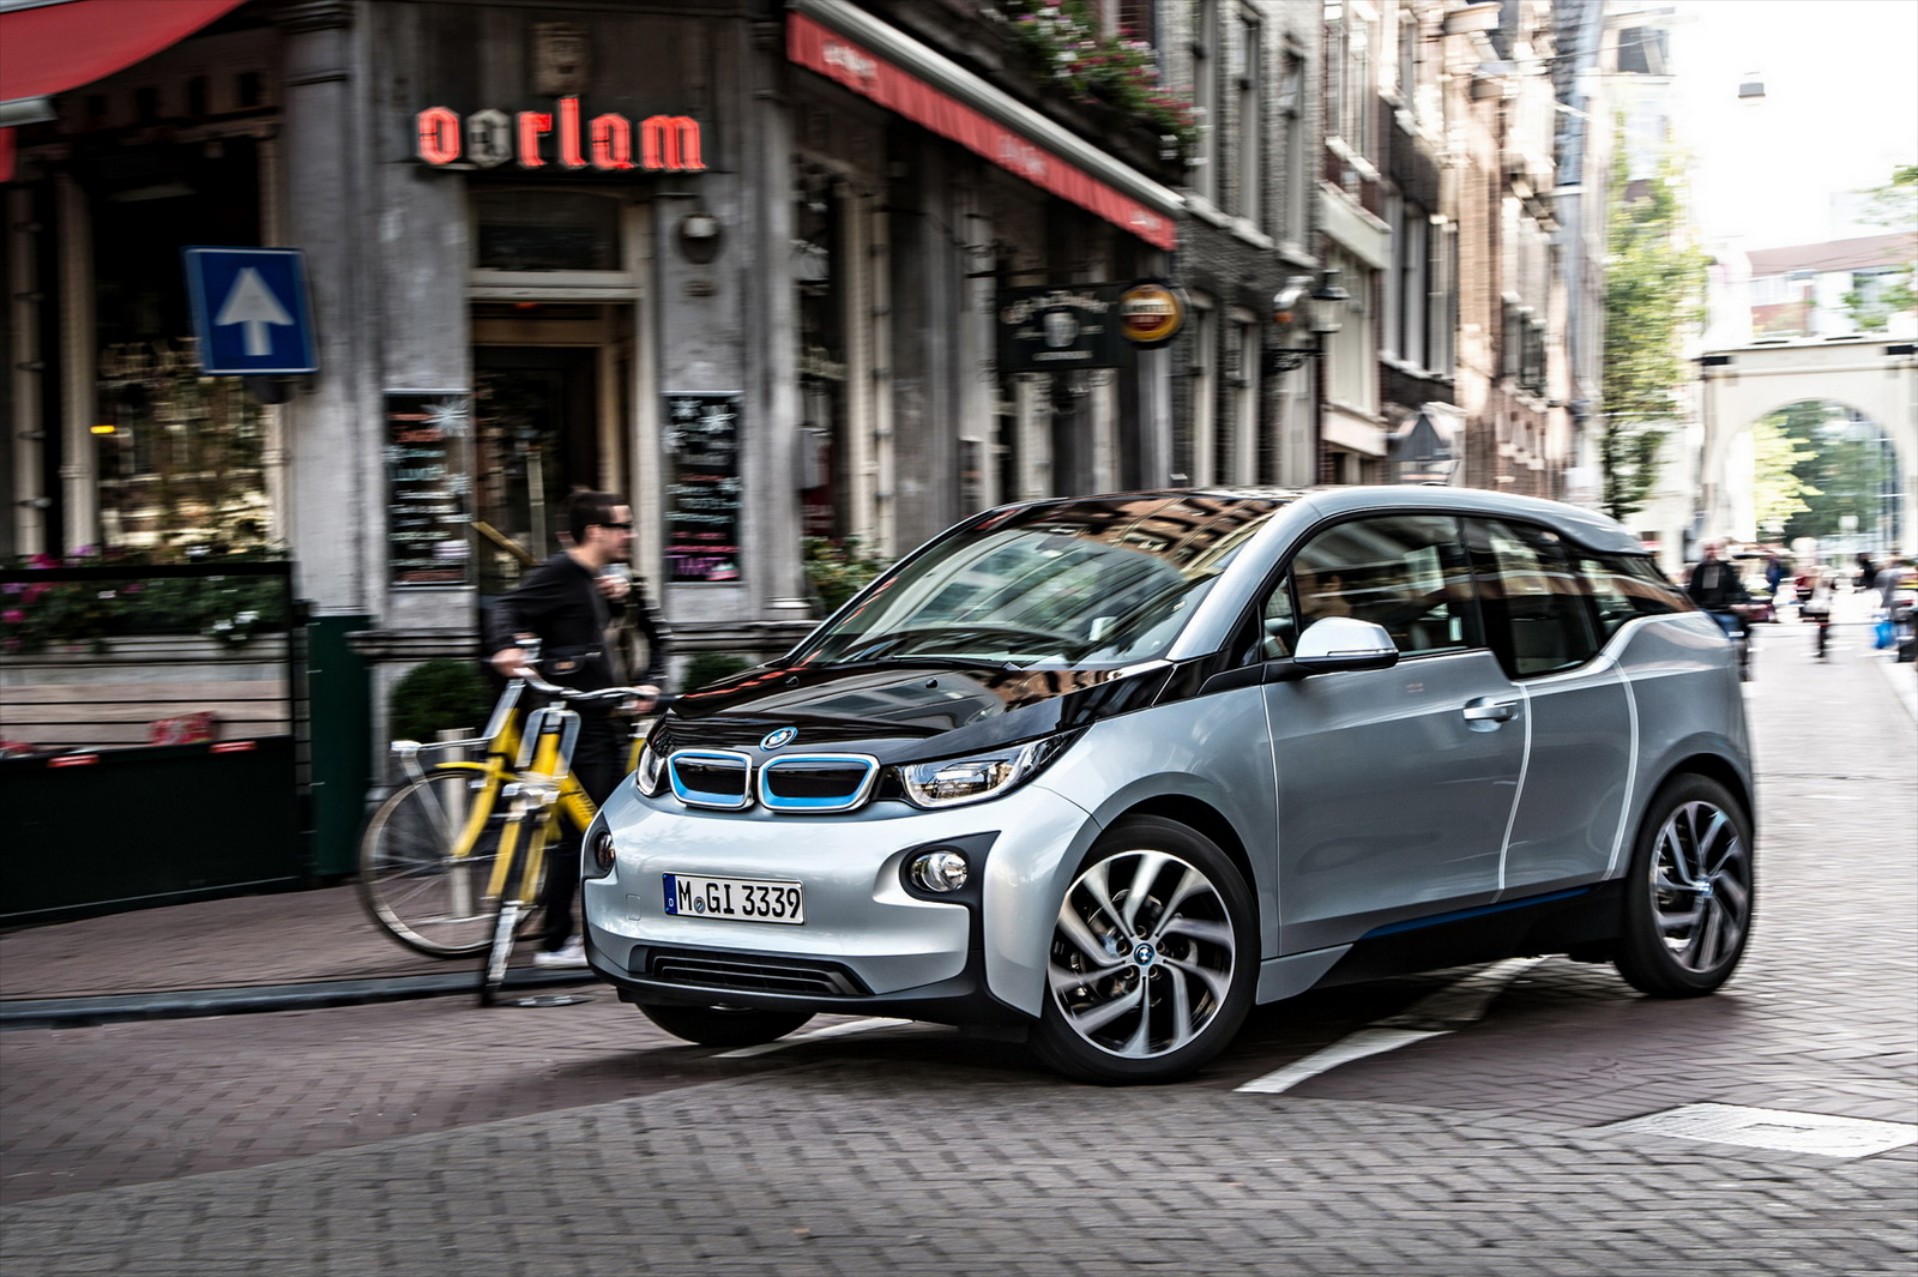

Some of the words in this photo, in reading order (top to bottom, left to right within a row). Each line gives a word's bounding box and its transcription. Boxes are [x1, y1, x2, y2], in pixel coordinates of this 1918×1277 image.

[416, 96, 707, 170] oorlam
[678, 880, 692, 911] M
[706, 883, 735, 915] GI
[741, 885, 801, 918] 3339
